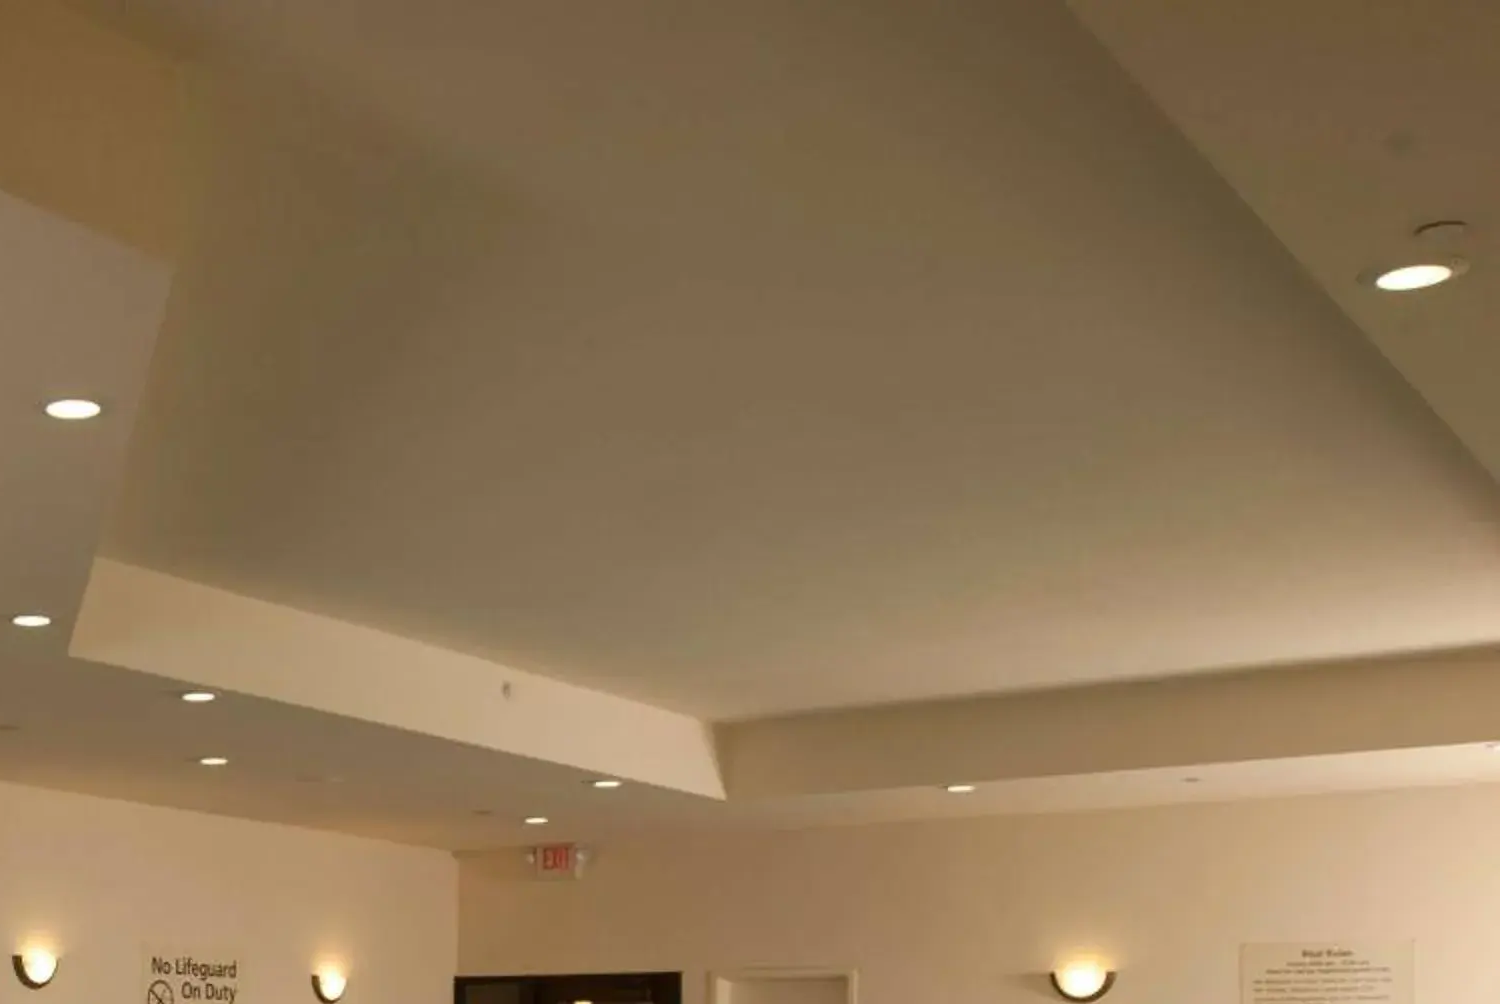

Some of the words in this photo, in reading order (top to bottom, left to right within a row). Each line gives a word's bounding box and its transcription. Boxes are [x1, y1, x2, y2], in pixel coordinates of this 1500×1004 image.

[151, 956, 171, 975] No
[175, 956, 237, 981] Lifeguard
[181, 981, 201, 999] On
